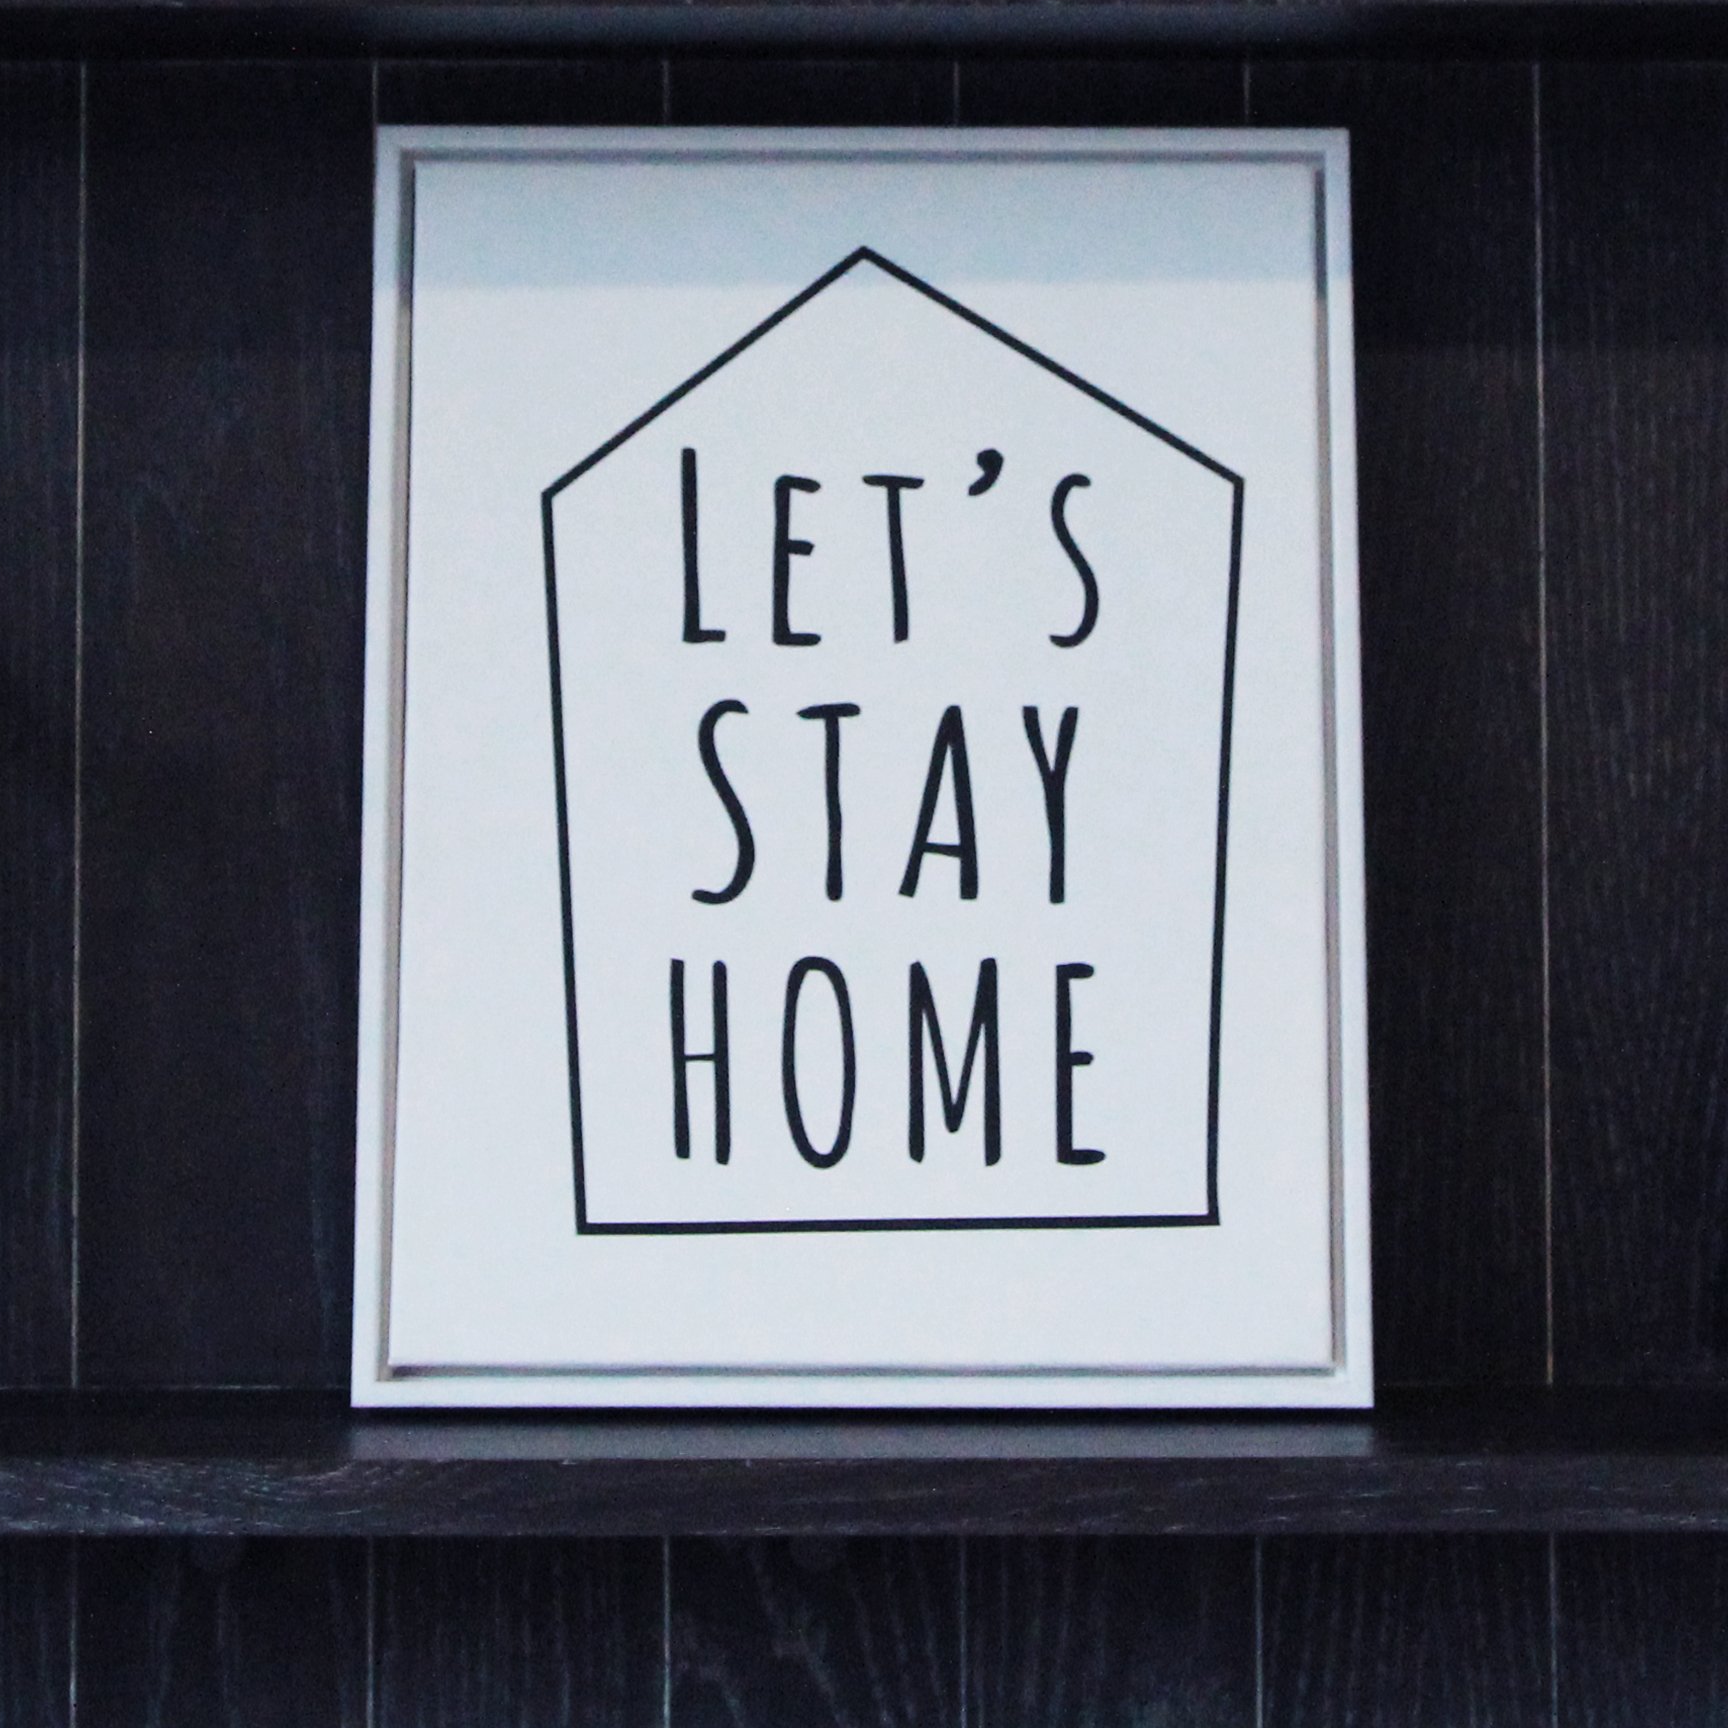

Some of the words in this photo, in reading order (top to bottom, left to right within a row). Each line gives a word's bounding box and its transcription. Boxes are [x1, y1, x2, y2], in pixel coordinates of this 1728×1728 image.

[681, 447, 1100, 648] LET'S
[691, 699, 1079, 905] STAY
[670, 956, 1106, 1169] HOME
